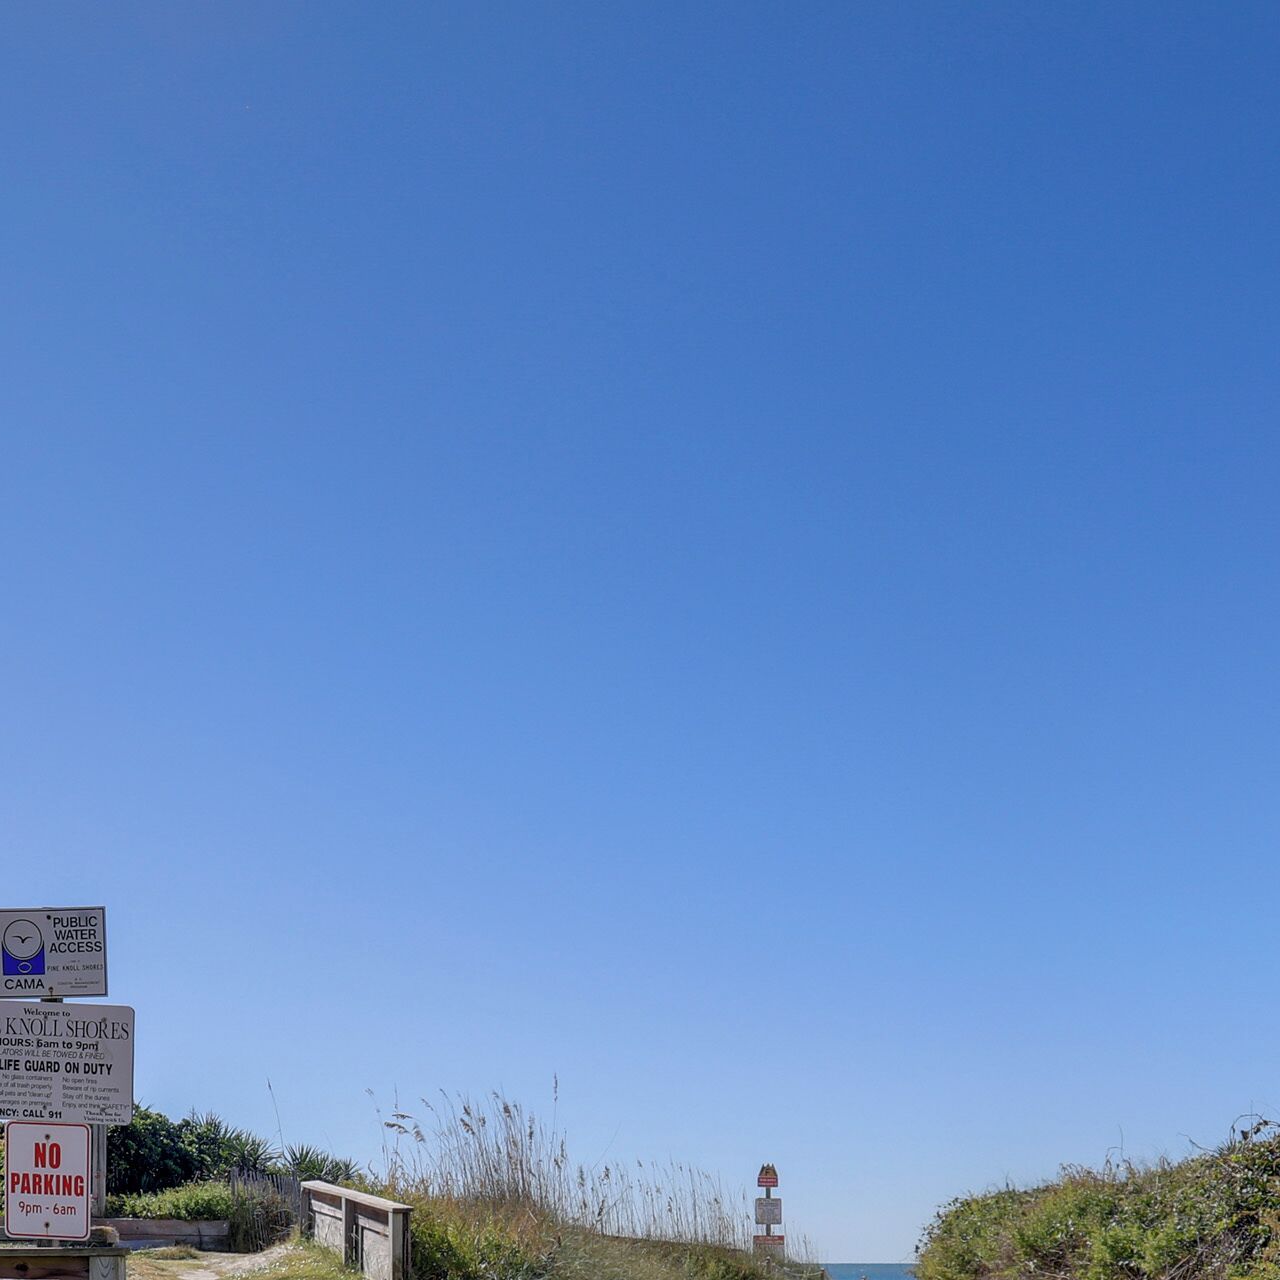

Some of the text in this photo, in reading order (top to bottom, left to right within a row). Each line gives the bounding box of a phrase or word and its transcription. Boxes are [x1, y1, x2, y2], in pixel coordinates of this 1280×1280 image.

[53, 916, 97, 928] PUBLIC
[55, 929, 97, 940] WATER
[49, 941, 102, 953] ACCESS
[4, 978, 45, 990] CAMA
[23, 1008, 60, 1016] Welcome
[6, 1017, 62, 1037] KNOLL
[66, 1020, 130, 1040] SHORES
[37, 1039, 59, 1048] 6am
[62, 1040, 72, 1049] to
[76, 1041, 99, 1051] 9pm
[24, 1049, 41, 1057] WILL
[53, 1050, 77, 1058] TOWED
[85, 1052, 105, 1060] FINED
[0, 1059, 20, 1071] LIFE
[24, 1060, 60, 1073] GUARD
[65, 1062, 79, 1074] ON
[83, 1062, 113, 1075] DUTY
[22, 1109, 44, 1118] CALL
[48, 1110, 62, 1119] 911
[34, 1142, 61, 1169] NO
[10, 1172, 85, 1197] PARKING
[18, 1201, 42, 1216] 9pm
[53, 1203, 76, 1215] 6am
